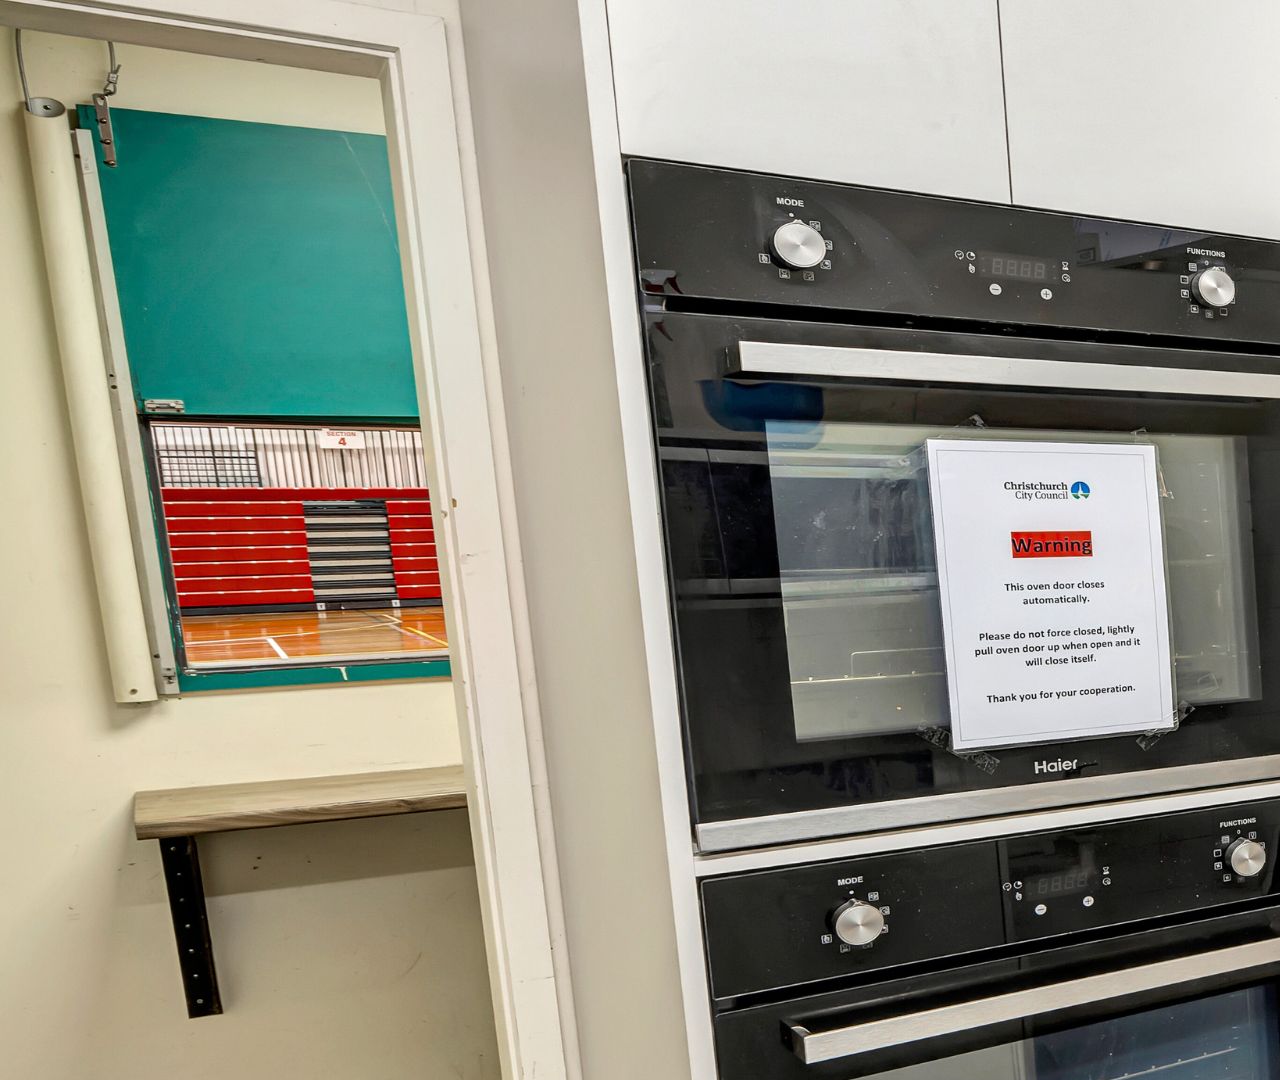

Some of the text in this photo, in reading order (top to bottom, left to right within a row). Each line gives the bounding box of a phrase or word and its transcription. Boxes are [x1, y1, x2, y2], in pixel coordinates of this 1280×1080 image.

[776, 197, 805, 208] MODE
[1186, 247, 1226, 258] FUNCTIONS
[338, 437, 347, 446] 4
[1003, 481, 1068, 491] Christchurch
[1015, 490, 1068, 501] City Council
[1011, 537, 1092, 555] Warning
[1004, 580, 1105, 592] This oven door closes
[1022, 594, 1090, 605] automatically.
[979, 624, 1135, 641] Please do not force closed, lightly
[974, 637, 1141, 657] pull oven door up when open and it
[1025, 653, 1097, 667] will close itself.
[986, 684, 1136, 703] Thank you for your cooperation.
[1034, 758, 1078, 774] Haier
[1219, 817, 1257, 828] FUNCTIONS
[837, 876, 864, 886] MODE
